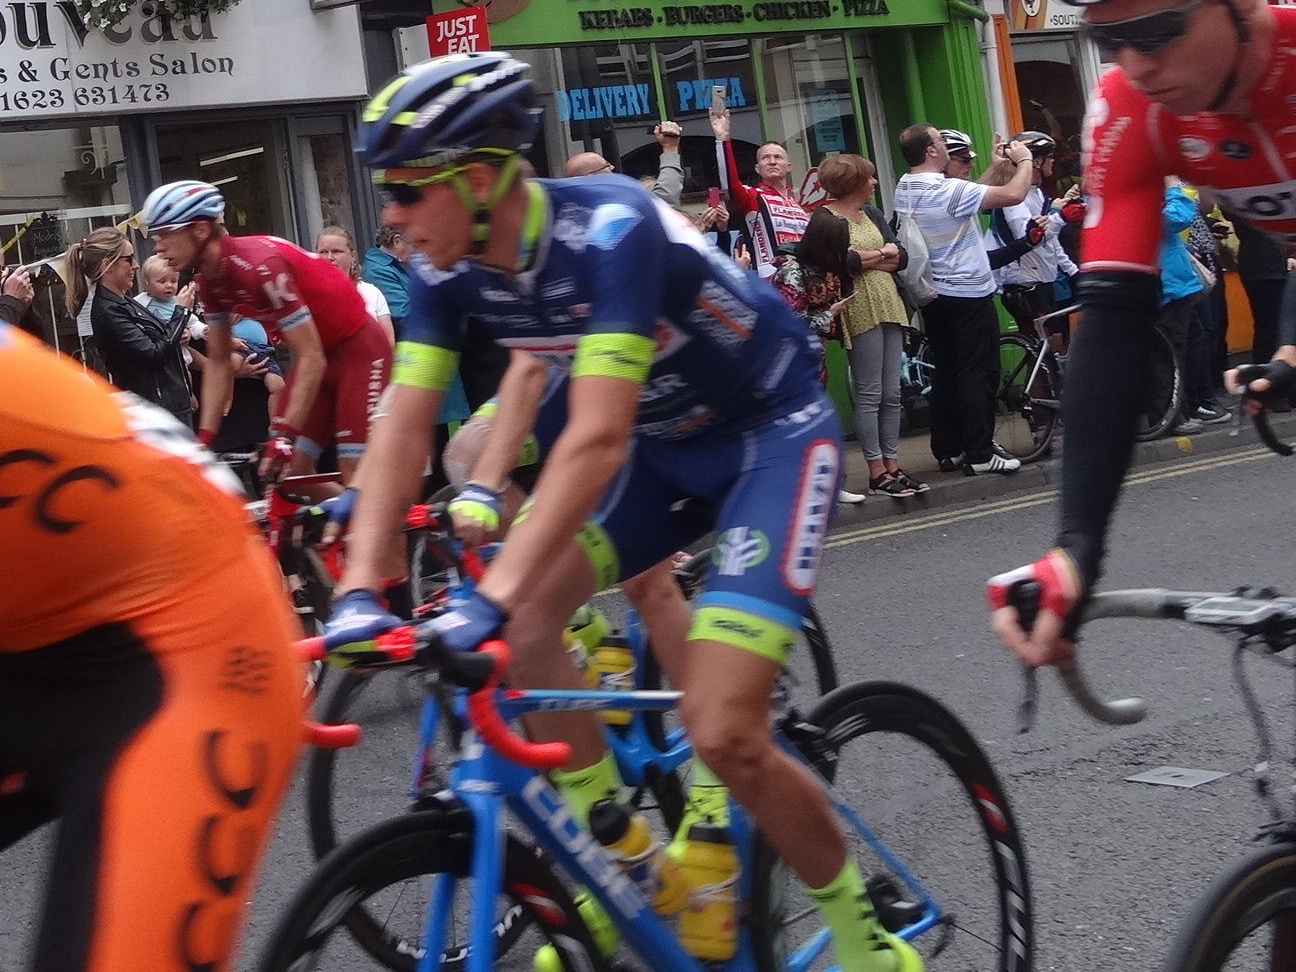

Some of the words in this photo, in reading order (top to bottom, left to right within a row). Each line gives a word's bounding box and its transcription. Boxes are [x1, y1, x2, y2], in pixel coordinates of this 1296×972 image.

[436, 15, 477, 42] JUST
[579, 7, 654, 30] KEBABS
[662, 3, 743, 25] BURGERS
[754, 0, 831, 22] CHICKEN
[447, 33, 480, 56] EAT
[17, 60, 40, 82] &
[49, 57, 141, 82] Gents
[149, 51, 235, 77] Salon
[74, 83, 170, 106] 631473
[555, 83, 650, 122] DELIVERY
